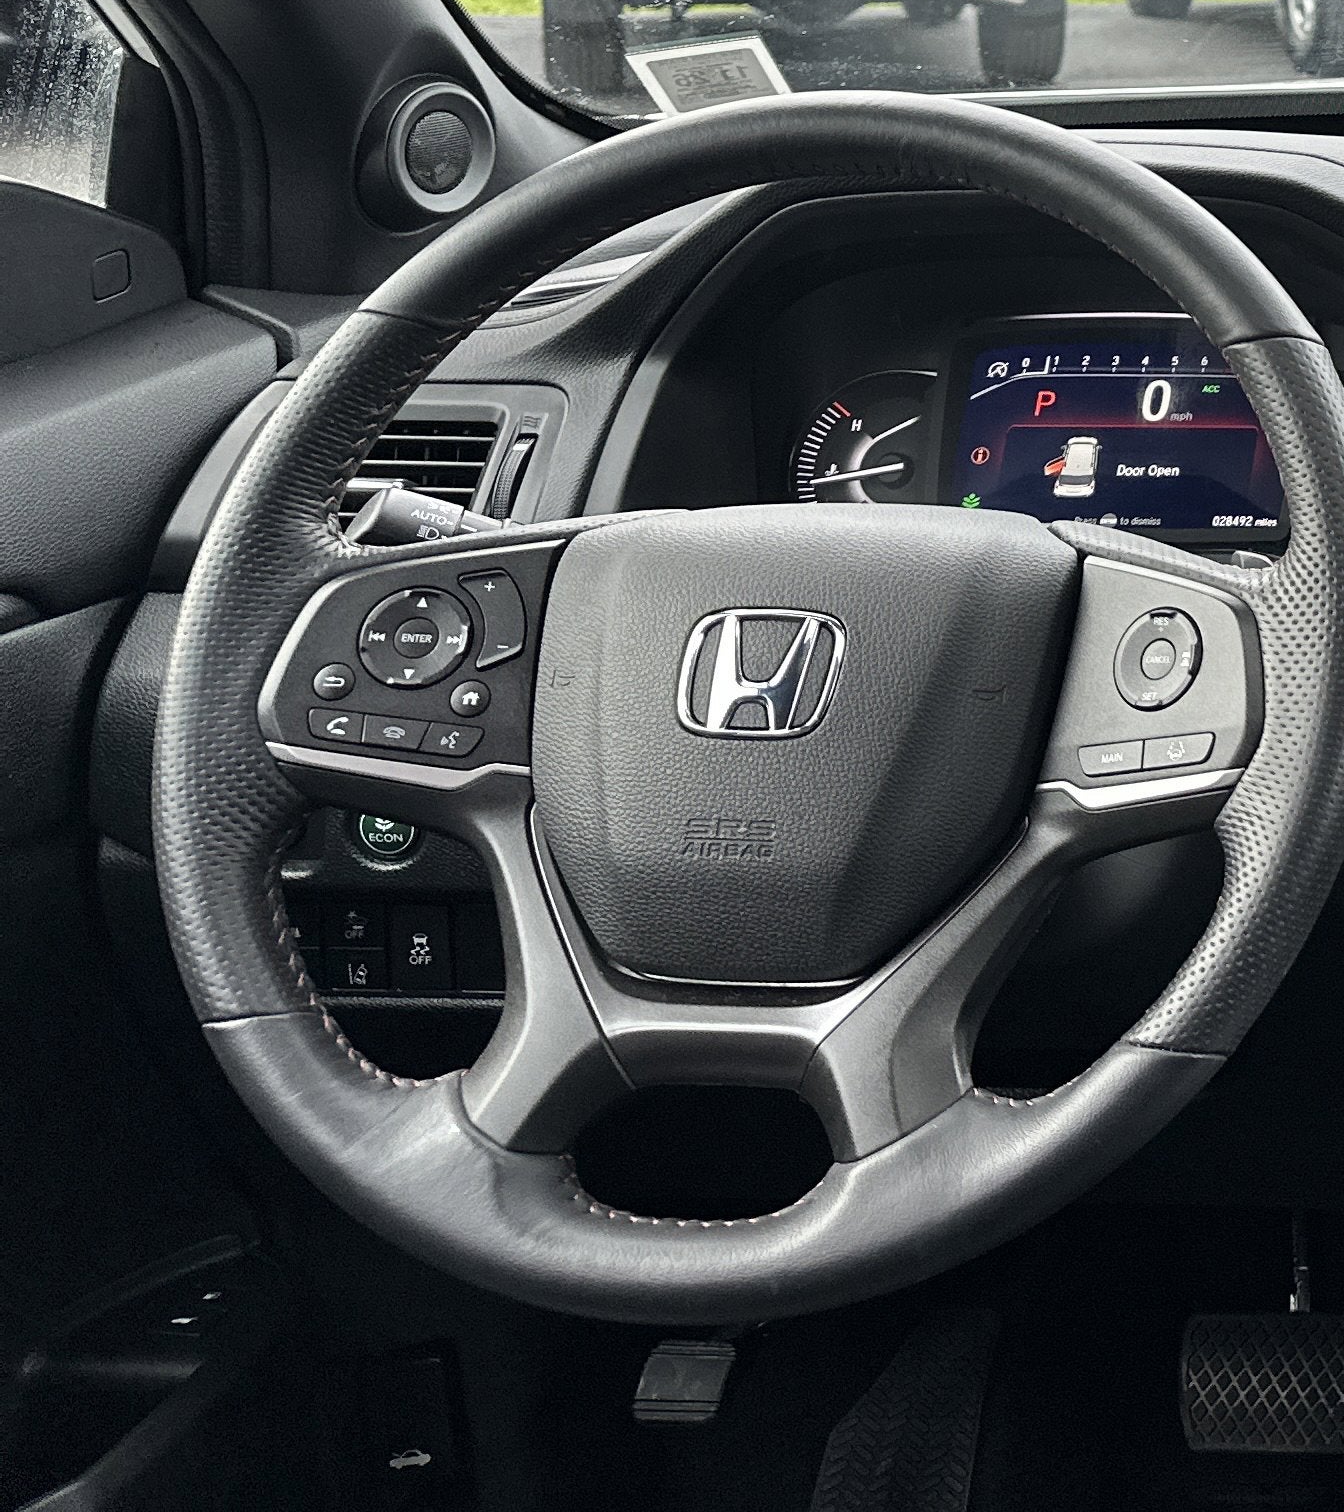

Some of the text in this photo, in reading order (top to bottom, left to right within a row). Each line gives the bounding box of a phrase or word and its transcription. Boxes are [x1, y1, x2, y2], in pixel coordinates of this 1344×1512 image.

[1021, 356, 1209, 367] 0 1 2 3 4 5 6
[1202, 385, 1221, 393] ACC
[1034, 390, 1056, 416] P
[1142, 379, 1193, 422] 0 mph
[851, 420, 863, 432] H
[1116, 463, 1180, 480] Door Open
[1119, 516, 1162, 526] to dismiss
[1212, 516, 1278, 527] 028492 miles
[1153, 617, 1169, 626] RES
[401, 633, 433, 644] ENTER
[1145, 656, 1171, 665] CANCEL
[1141, 692, 1159, 701] SET
[1101, 752, 1124, 764] MAIN
[684, 818, 777, 837] SRS
[368, 833, 404, 843] ECON
[682, 841, 775, 859] AIRBAG
[408, 956, 432, 965] OFF
